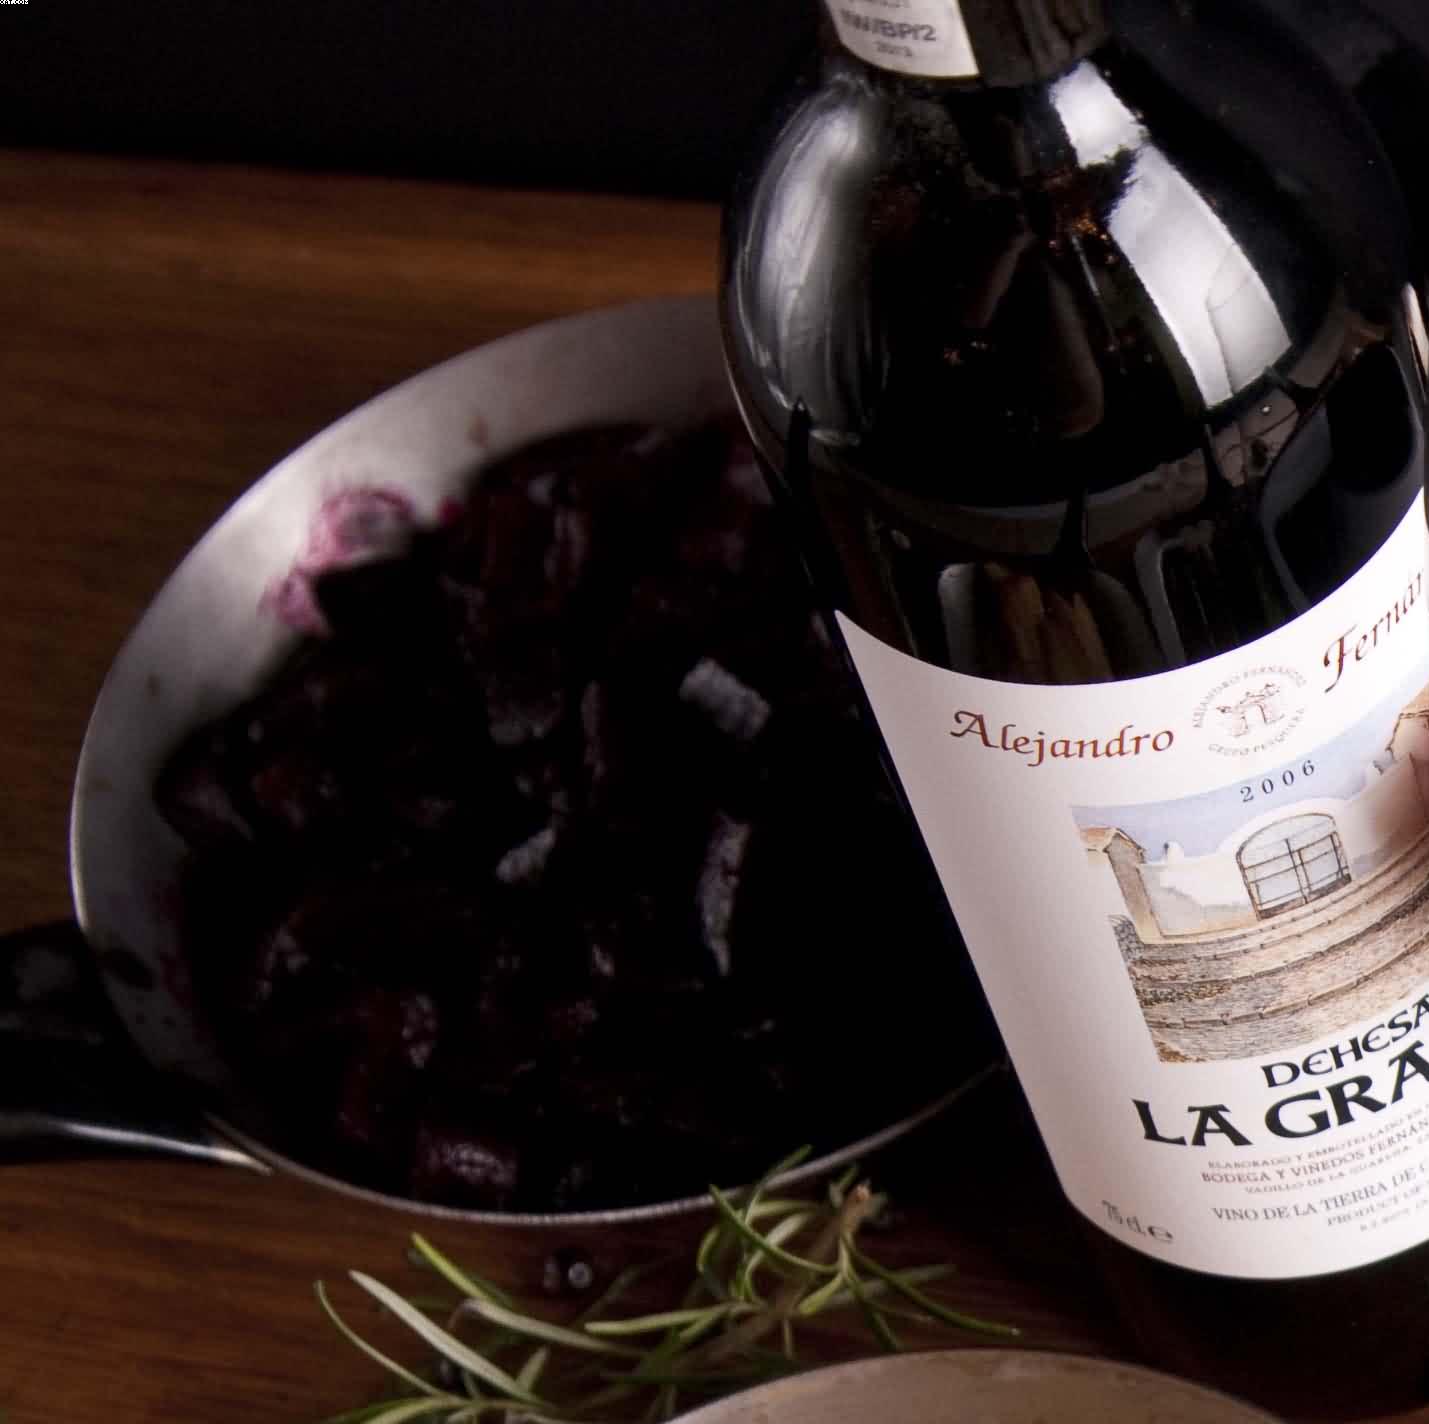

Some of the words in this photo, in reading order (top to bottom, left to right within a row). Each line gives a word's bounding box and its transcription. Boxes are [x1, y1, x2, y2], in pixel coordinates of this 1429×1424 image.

[950, 710, 1175, 767] Alejandro
[1240, 759, 1317, 803] 2006
[1132, 1098, 1254, 1147] LA
[1201, 1171, 1271, 1184] BODEGA
[1275, 1168, 1287, 1180] Y
[1210, 1207, 1260, 1222] VINO
[1263, 1205, 1290, 1221] DE
[1293, 1202, 1319, 1217] LA
[1320, 1181, 1389, 1211] TIERRA
[1391, 1167, 1417, 1188] DE
